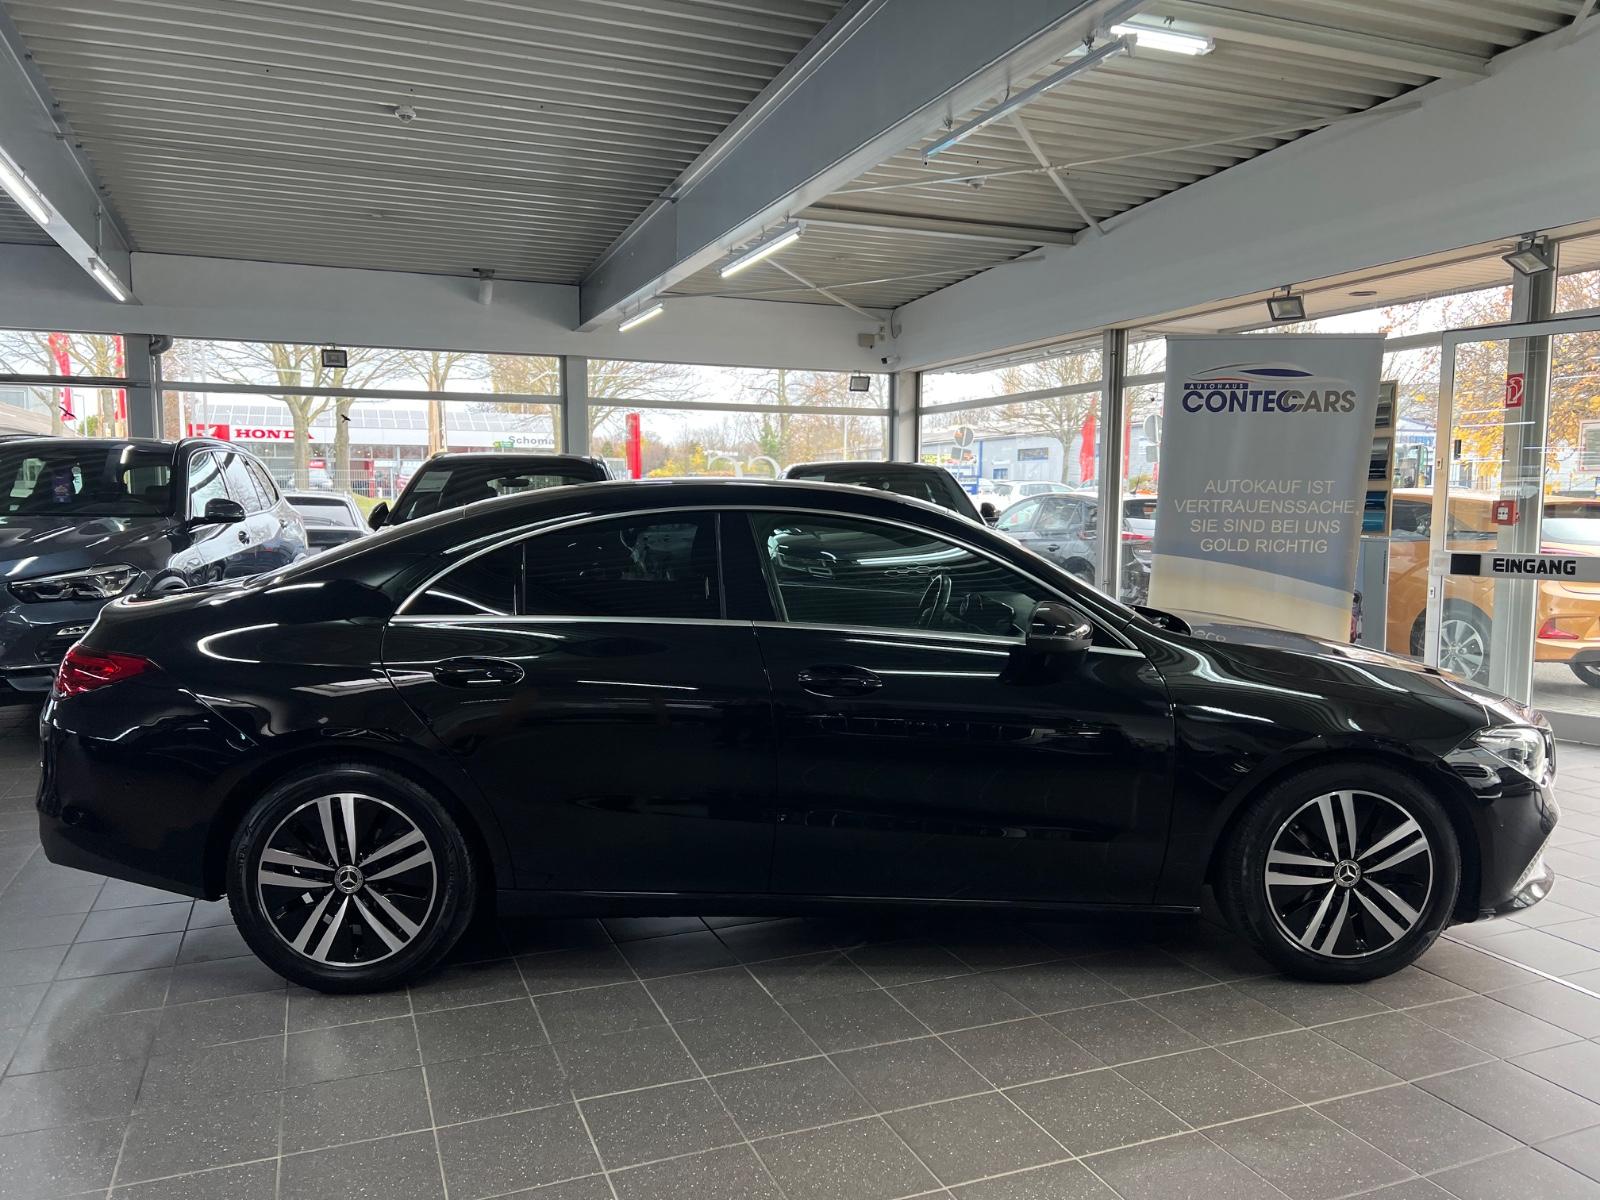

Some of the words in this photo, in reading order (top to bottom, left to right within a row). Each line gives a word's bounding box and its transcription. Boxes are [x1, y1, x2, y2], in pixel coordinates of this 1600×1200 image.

[1204, 480, 1302, 494] AUTOKAUF
[1307, 480, 1335, 494] IST
[1190, 519, 1218, 533] SIE
[1223, 519, 1265, 533] SIND
[1271, 520, 1299, 533] BEI
[1305, 520, 1340, 534] UNS
[1200, 538, 1250, 552] GOLD
[1255, 539, 1328, 553] RICHTIG
[1493, 558, 1576, 575] EINGANG
